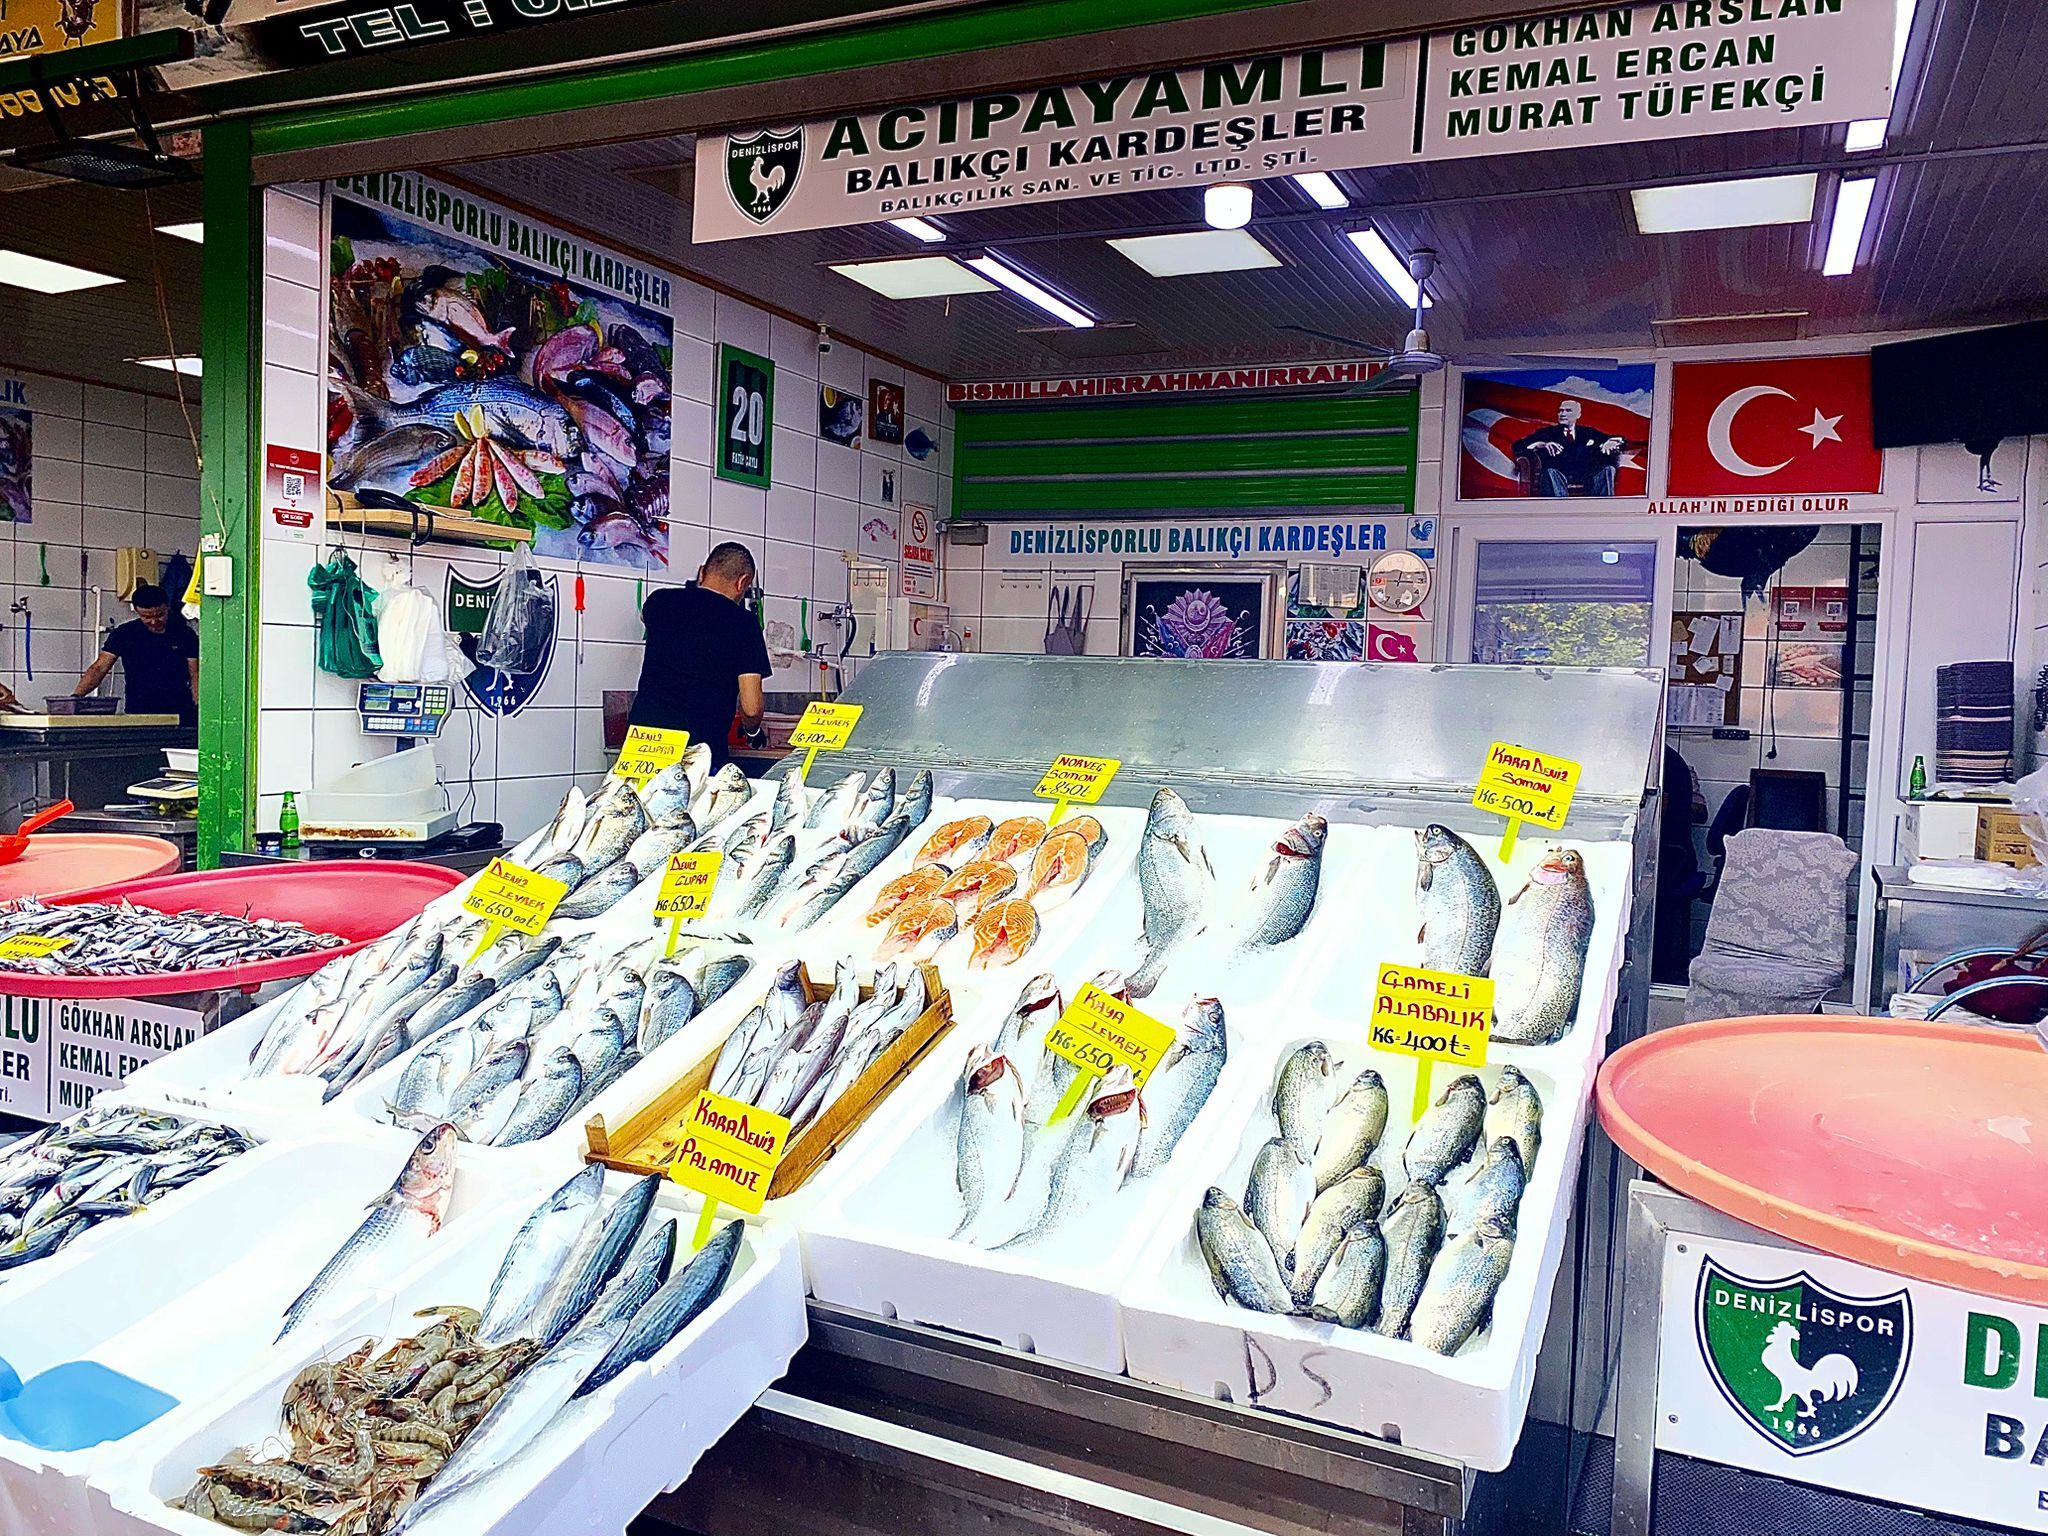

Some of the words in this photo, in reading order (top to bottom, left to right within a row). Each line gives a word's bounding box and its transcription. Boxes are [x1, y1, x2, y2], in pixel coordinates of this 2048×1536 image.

[300, 5, 449, 54] TEL
[1450, 54, 1597, 98] KEMAL
[1616, 34, 1775, 79] ERCAN
[821, 42, 1386, 160] ACIPAYAMLI
[1447, 95, 1600, 138] MURAT
[1618, 66, 1825, 119] TÜFEKÇİ
[731, 140, 799, 158] DENİZLİSPOR
[847, 146, 1028, 194] BALIKÇI
[1049, 104, 1367, 167] KARDEŞLER
[880, 185, 1013, 213] BALIKÇILIK
[1022, 177, 1080, 195] SAN.
[1090, 173, 1121, 187] VE
[1130, 163, 1183, 182] TİC.
[1195, 157, 1250, 174] LTD.
[1263, 147, 1318, 171] ŞTİ.
[508, 219, 578, 279] BALIKÇI
[582, 251, 671, 308] KARDEŞLER
[731, 386, 764, 446] 20
[1734, 497, 1795, 513] DEDİĞİ
[1802, 498, 1849, 512] OLUR
[1011, 525, 1161, 554] DENİZLİSPORLU
[1169, 527, 1251, 558] BALIKÇI
[1259, 524, 1387, 557] KARDEŞLER
[455, 592, 497, 609] DENİ
[490, 696, 516, 706] 1966
[1493, 772, 1552, 794] SOMON
[0, 995, 39, 1043] LU
[61, 1001, 124, 1041] GÖKHAN
[1083, 991, 1125, 1024] KAYA
[1376, 996, 1484, 1031] ALABALIK
[0, 1050, 30, 1081] ER
[60, 1042, 113, 1077] KEMAL
[1080, 1021, 1148, 1062] LEVREK
[60, 1080, 103, 1110] MUR
[1714, 1289, 1895, 1336] DENİZLİSPOR
[1772, 1416, 1822, 1438] 1966
